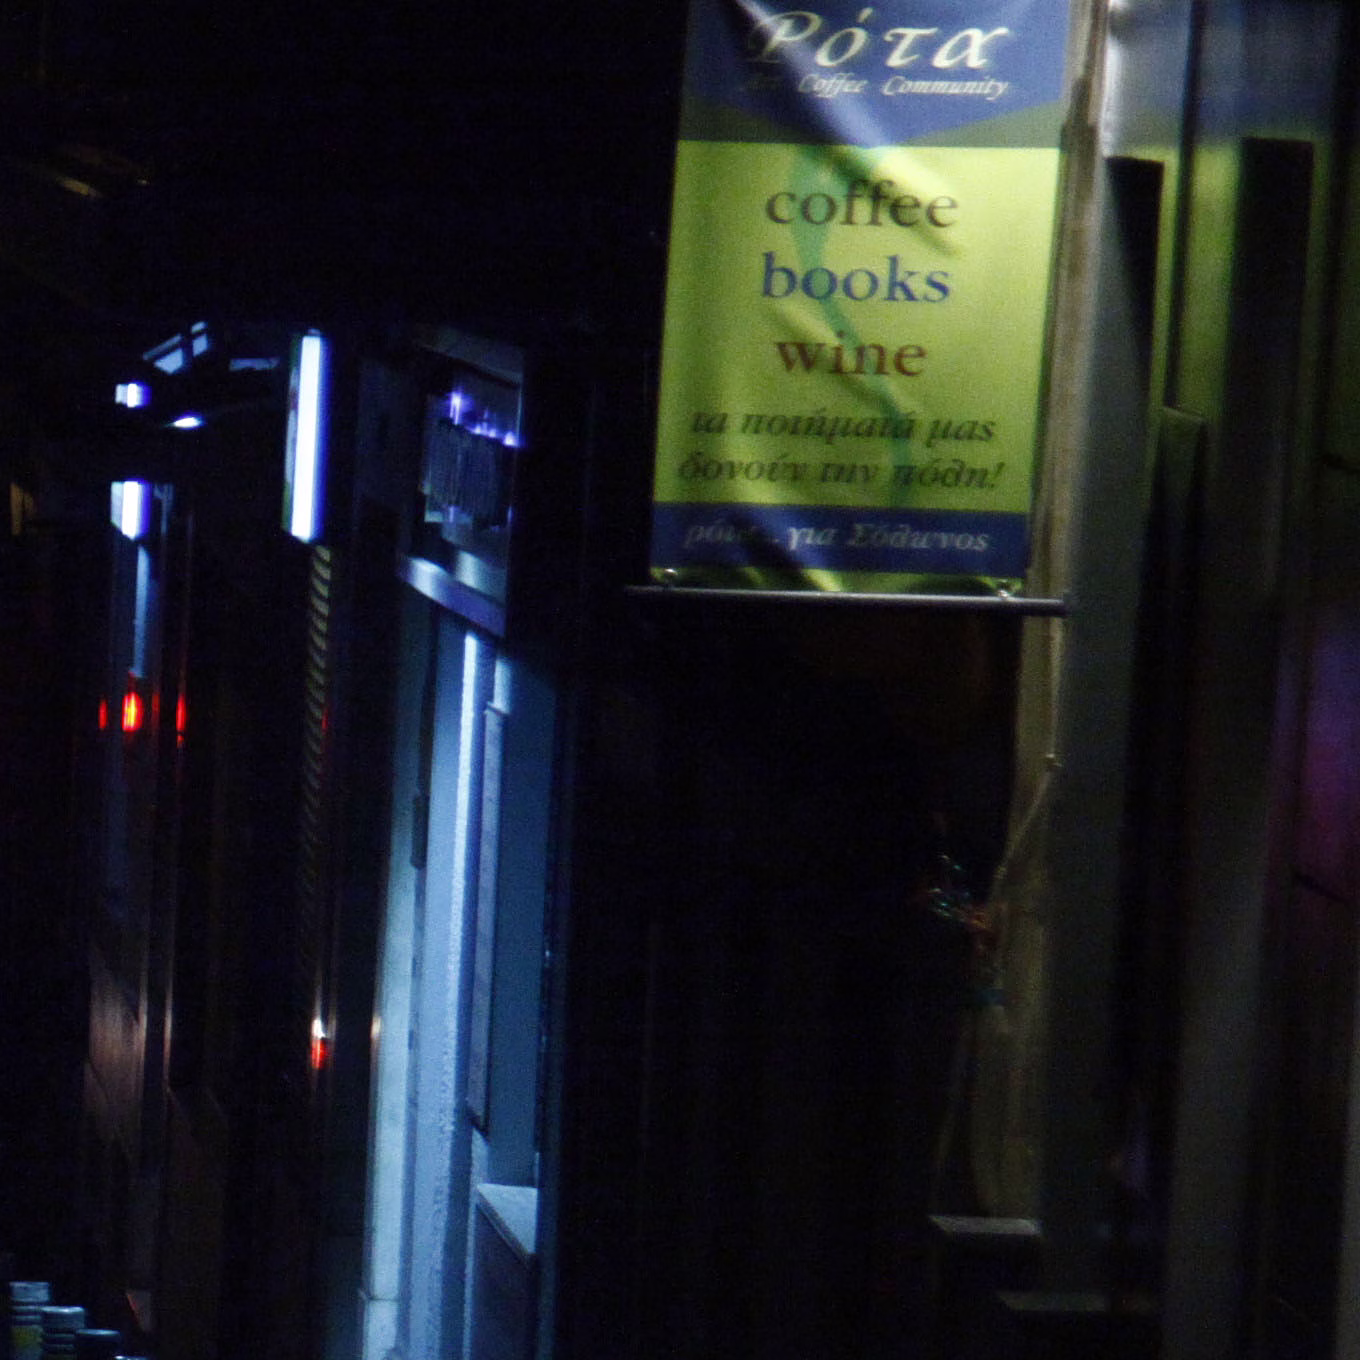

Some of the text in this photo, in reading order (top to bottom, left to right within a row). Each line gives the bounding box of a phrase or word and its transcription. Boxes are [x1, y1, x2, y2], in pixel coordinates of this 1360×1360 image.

[746, 7, 1010, 69] Ρότα
[798, 72, 868, 98] Coffee
[881, 75, 1010, 101] Community
[765, 179, 960, 228] coffee
[761, 251, 951, 303] books
[775, 330, 928, 377] wine
[925, 416, 997, 448] μας
[820, 461, 879, 485] την
[892, 457, 1006, 489] πόλη!
[787, 525, 840, 553] για
